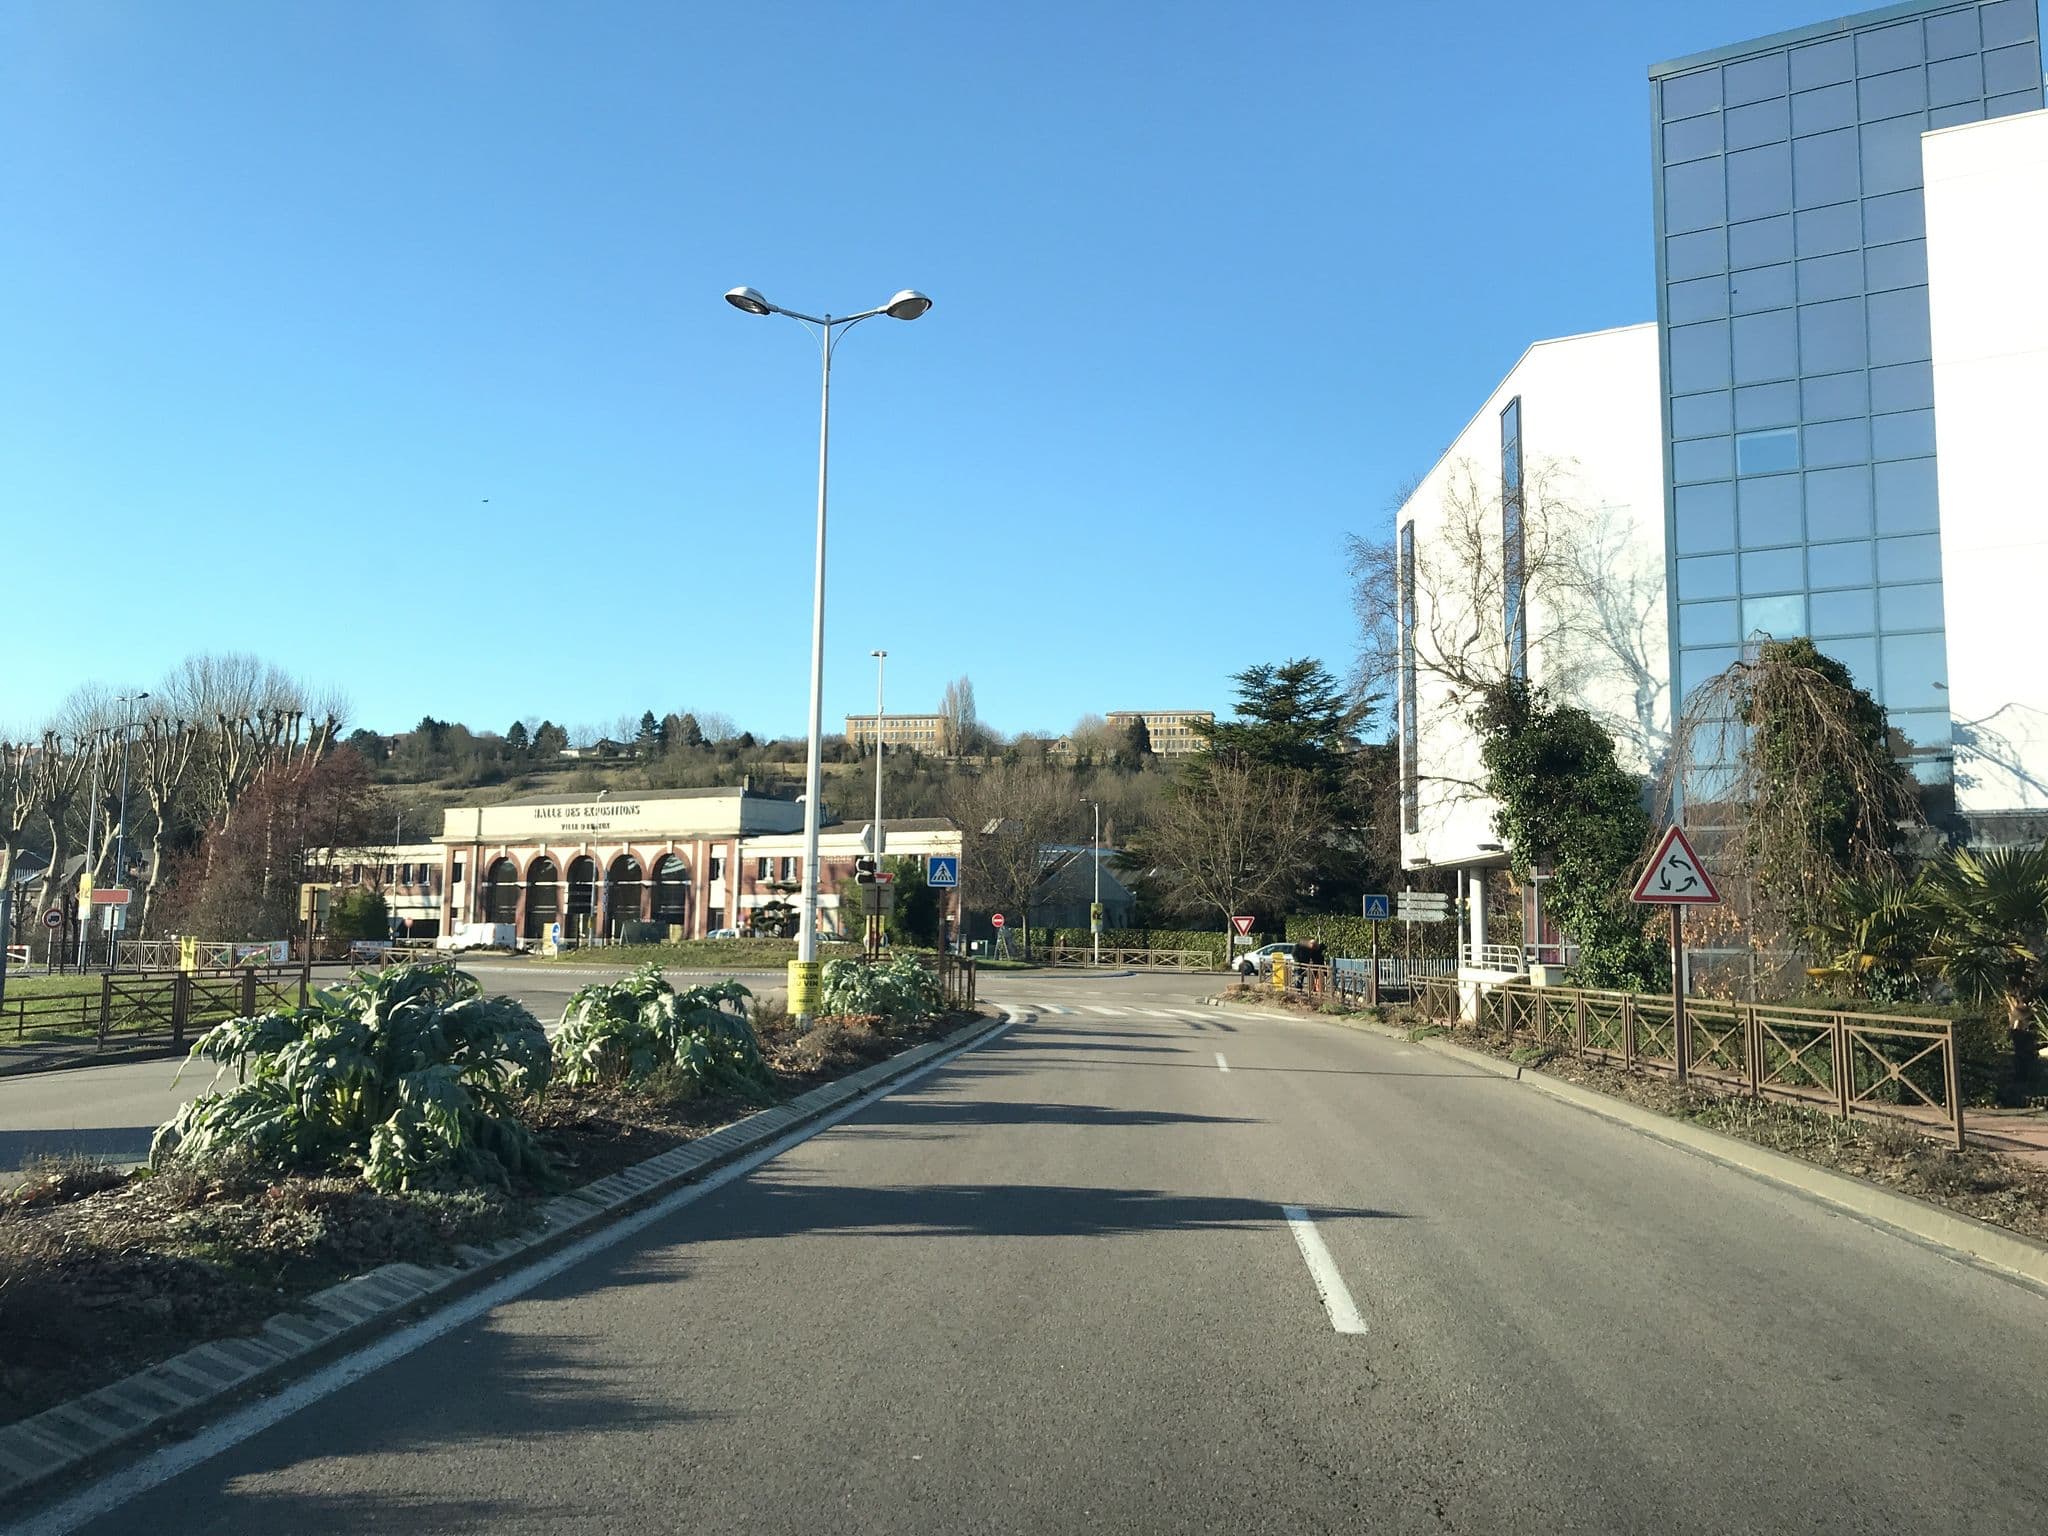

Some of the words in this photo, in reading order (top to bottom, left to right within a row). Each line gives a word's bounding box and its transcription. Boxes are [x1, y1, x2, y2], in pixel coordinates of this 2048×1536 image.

[534, 808, 562, 818] HALLE
[565, 807, 581, 818] DES
[584, 805, 640, 816] EXPOSITIONS
[561, 823, 579, 831] VILLE
